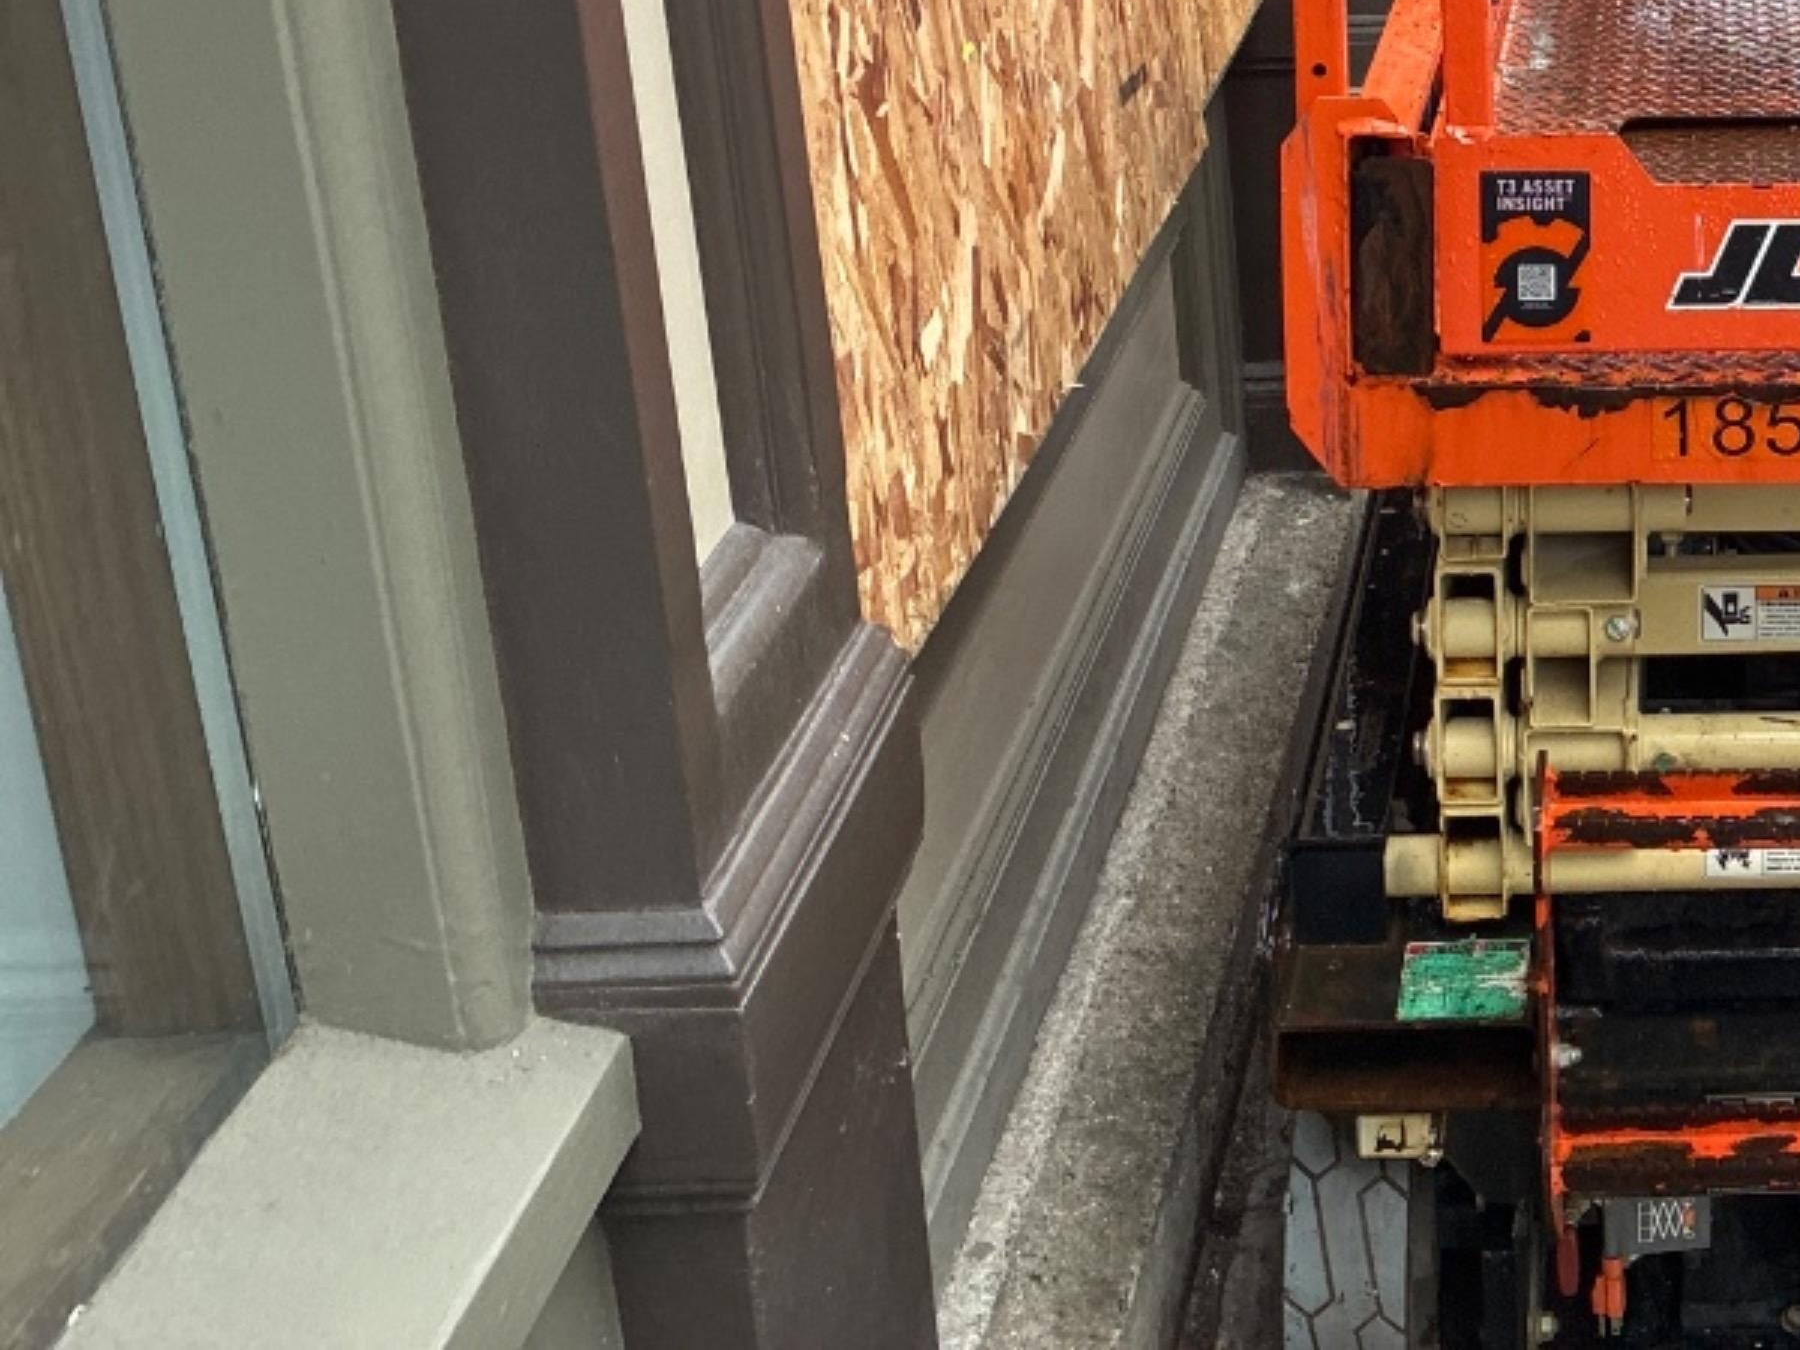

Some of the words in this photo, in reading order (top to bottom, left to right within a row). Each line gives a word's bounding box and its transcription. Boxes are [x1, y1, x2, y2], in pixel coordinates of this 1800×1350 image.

[1497, 179, 1516, 194] T3
[1522, 178, 1575, 195] ASSET
[1497, 197, 1565, 211] INSIGHT
